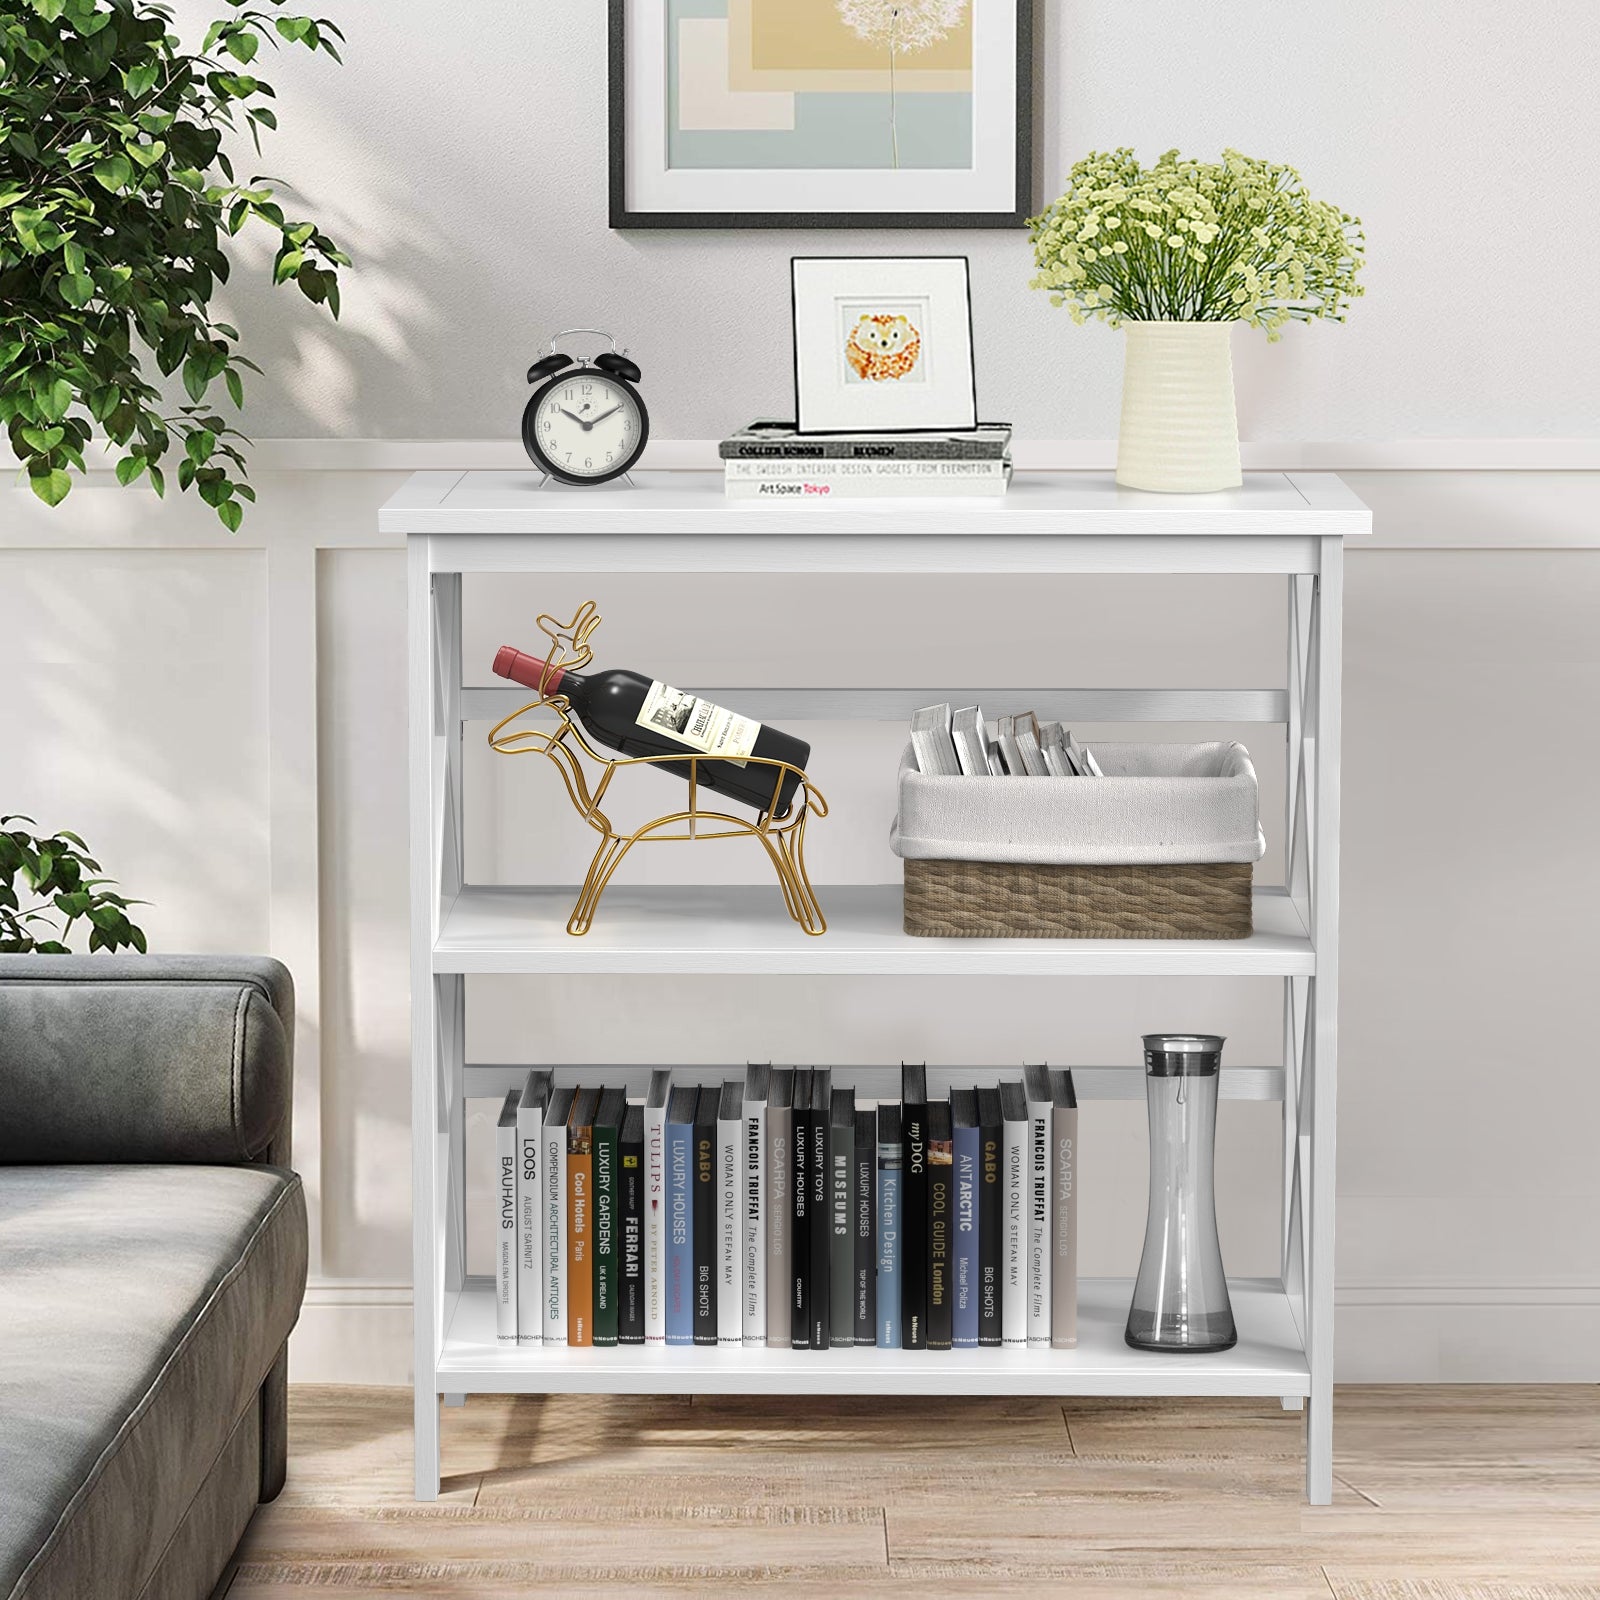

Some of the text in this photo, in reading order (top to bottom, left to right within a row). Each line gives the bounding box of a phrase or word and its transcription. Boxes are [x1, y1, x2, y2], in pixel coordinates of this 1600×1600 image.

[550, 402, 561, 413] 10
[565, 389, 573, 400] 11
[581, 384, 593, 395] 12
[605, 389, 609, 400] 1
[618, 402, 624, 413] 2
[543, 421, 551, 432] 9
[549, 440, 557, 450] 8
[618, 439, 624, 449] 4
[624, 420, 631, 431] 3
[565, 452, 573, 463] 7
[584, 457, 592, 468] 6
[605, 451, 613, 462] 5
[841, 464, 872, 474] DESIGN
[759, 483, 831, 496] Art Space Tokyo
[524, 1139, 536, 1180] LOOS
[650, 1124, 661, 1192] TULIPS
[699, 1140, 711, 1183] GABO
[725, 1144, 734, 1187] WOMAN
[774, 1138, 785, 1199] SCARPA
[815, 1126, 823, 1201] LUXURY TOYS
[908, 1122, 923, 1174] my DOG
[985, 1141, 996, 1183] GABO
[502, 1156, 513, 1229] BAUHAUS
[575, 1172, 585, 1261] Cool Hotels Paris
[599, 1142, 610, 1254] LUXURY GARDENS
[673, 1140, 686, 1244] LUXURY HOUSES
[725, 1191, 733, 1220] ONLY
[747, 1118, 759, 1317] FRANCOIS TRUFFAT The Complete Films
[834, 1155, 847, 1235] MUSEUMS
[860, 1162, 869, 1237] LUXURY HOUSES
[959, 1154, 972, 1231] ANTARCTIC
[1010, 1145, 1020, 1286] WOMAN ONLY STEFAN MAY
[1059, 1138, 1072, 1256] SCARPA SERGIO LOS
[524, 1196, 532, 1269] AUGUST SARNITZ
[549, 1141, 559, 1320] COMPENDIUM ARCHITECTURAL ANTIQUES
[651, 1223, 657, 1236] BY
[774, 1204, 782, 1236] SERGIO
[881, 1178, 897, 1272] Kitchen Design
[933, 1182, 945, 1305] COOL GUIDE London
[1032, 1119, 1045, 1318] FRANCOIS TRUFFAT The Complete Films
[599, 1265, 606, 1275] UK
[626, 1217, 638, 1277] FERRARI
[699, 1265, 709, 1317] BIG SHOTS
[959, 1257, 968, 1309] Michael Poliza
[984, 1266, 994, 1318] BIG SHOTS
